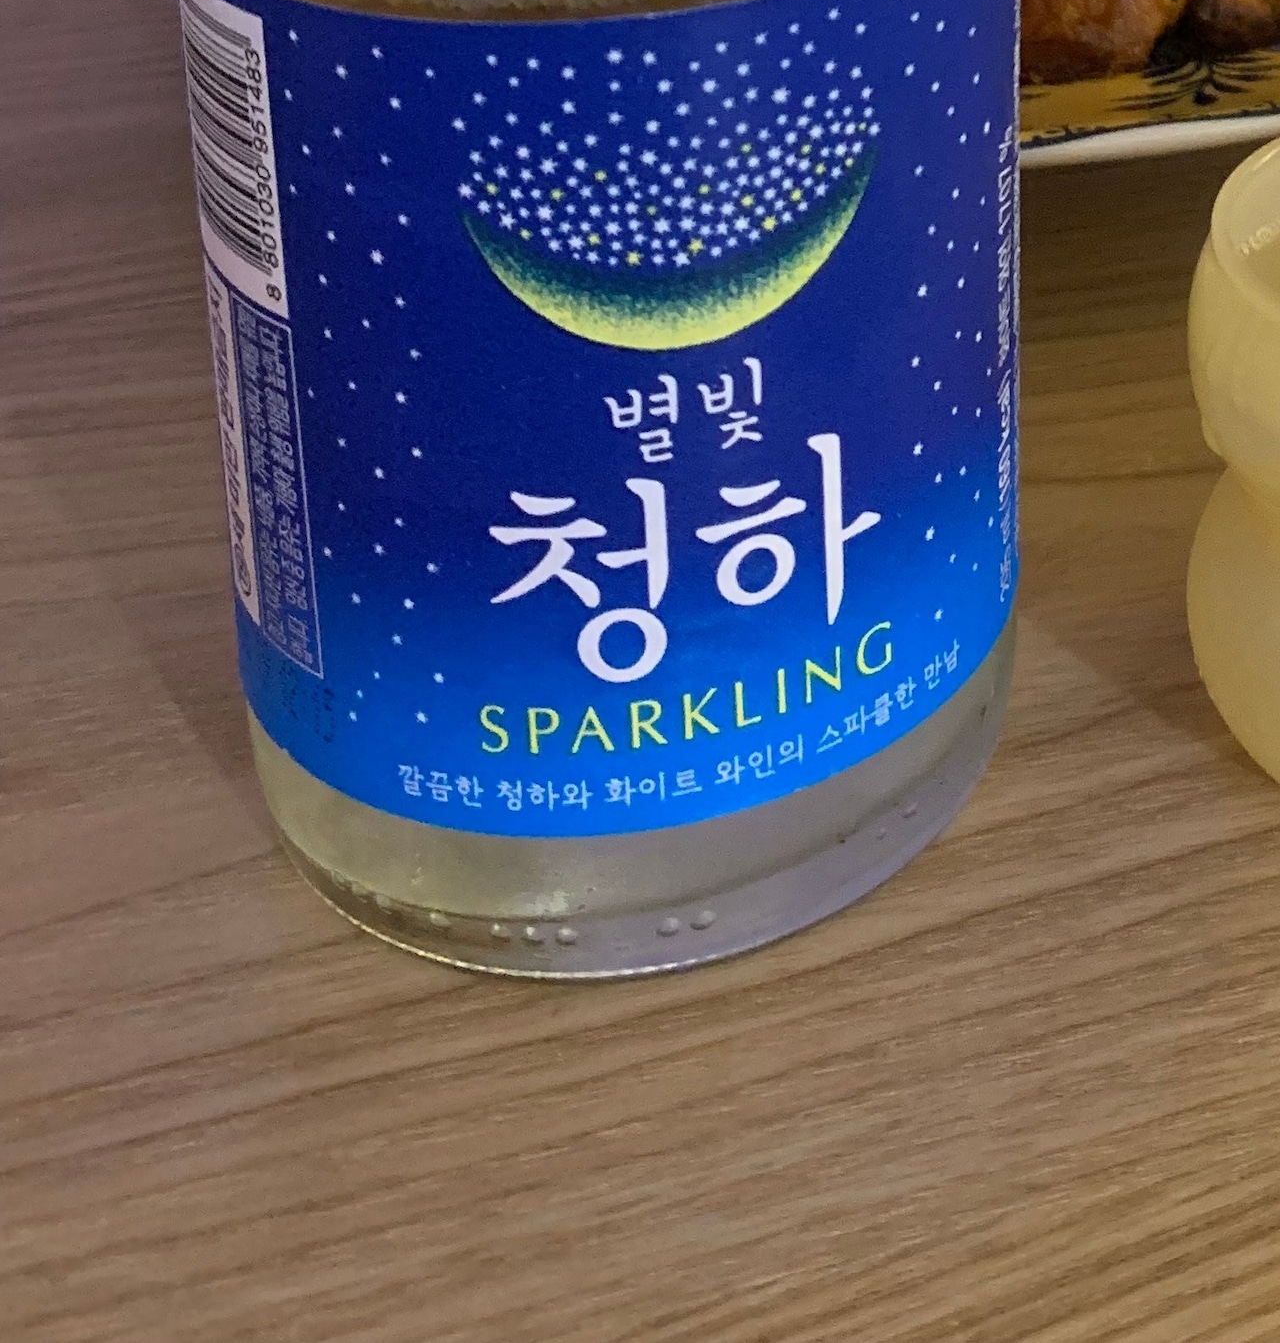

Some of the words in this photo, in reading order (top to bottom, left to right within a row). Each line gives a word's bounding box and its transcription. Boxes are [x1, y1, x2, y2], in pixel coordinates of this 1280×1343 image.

[243, 47, 269, 154] 951483
[253, 161, 280, 269] 801030
[264, 284, 282, 302] 8
[603, 356, 763, 464] 별빛
[277, 509, 304, 566] 음주는
[487, 432, 882, 684] 청하
[283, 572, 308, 616] 임신
[397, 763, 484, 808] 깔끔한
[496, 781, 594, 812] 청하와
[604, 769, 704, 807] 화이트
[714, 733, 804, 786] 와인의
[923, 637, 961, 691] 만남
[479, 620, 893, 755] SPARKLING
